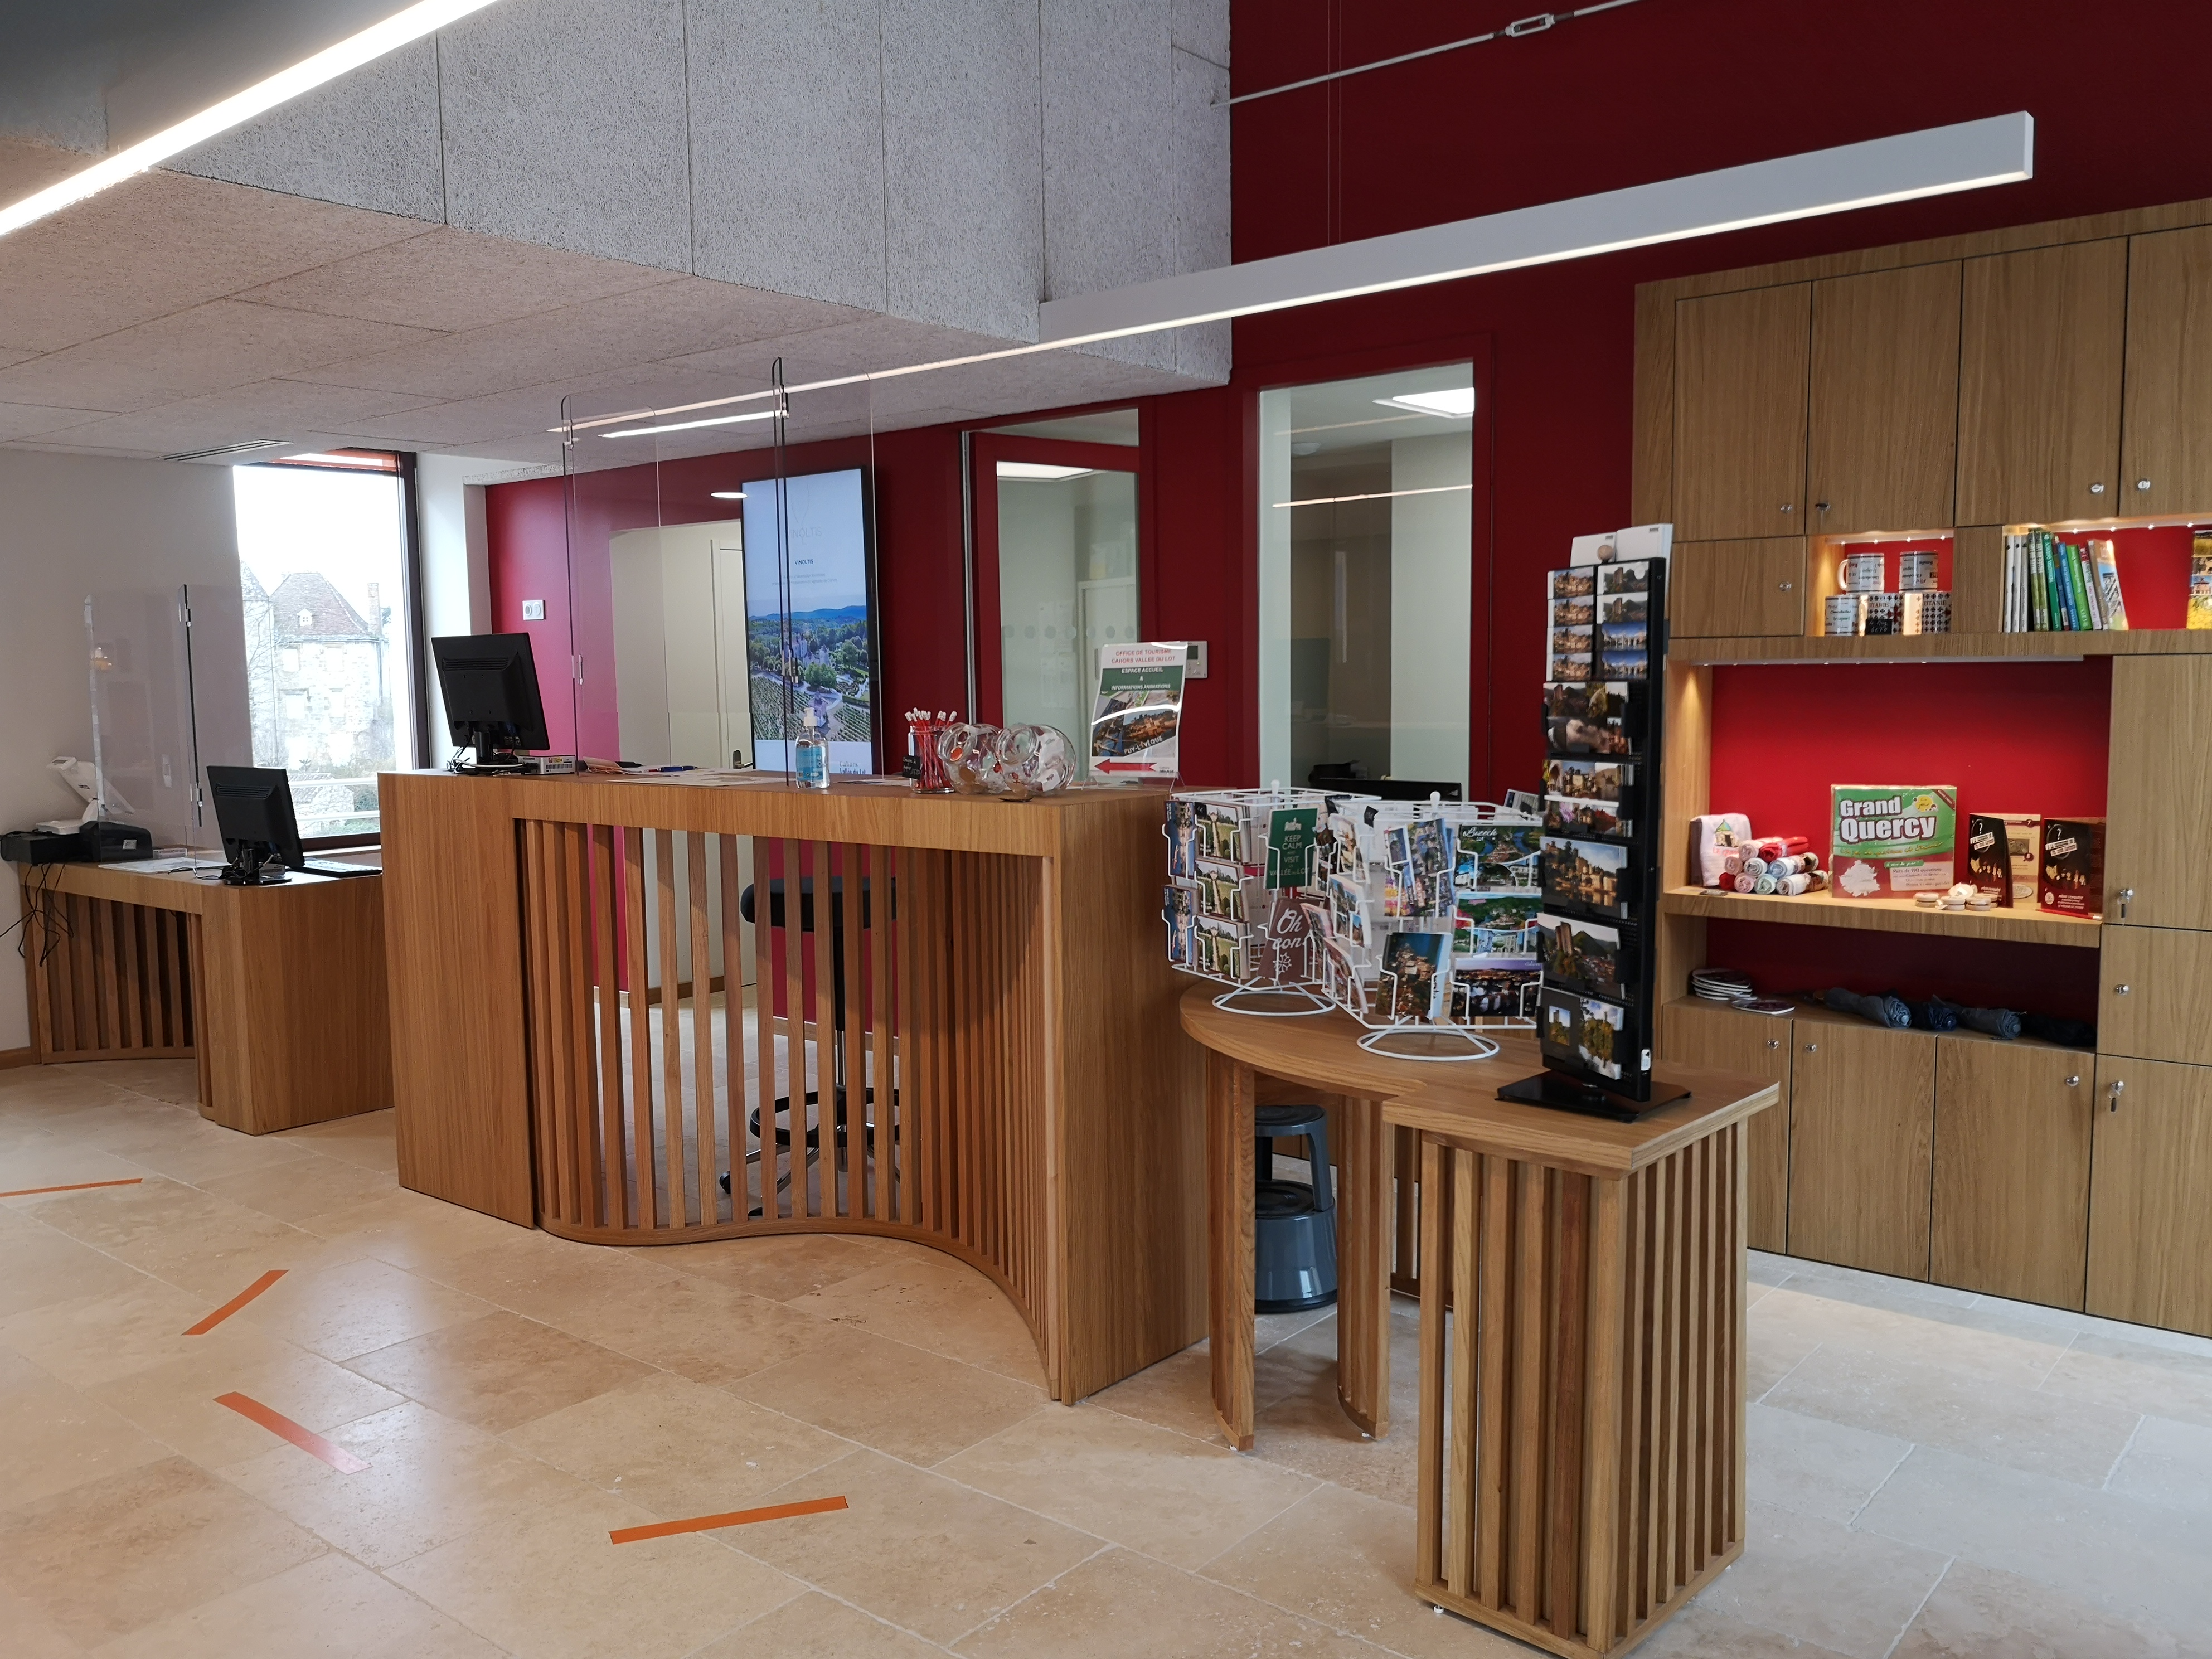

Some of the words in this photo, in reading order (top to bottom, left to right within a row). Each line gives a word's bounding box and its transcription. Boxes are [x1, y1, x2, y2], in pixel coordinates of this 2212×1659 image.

[784, 527, 822, 539] INOLTIS
[1840, 797, 1901, 817] Grand
[1463, 826, 1498, 838] Luzech
[1840, 817, 1936, 842] Quercy
[1277, 908, 1303, 934] Oh
[1272, 937, 1305, 950] con
